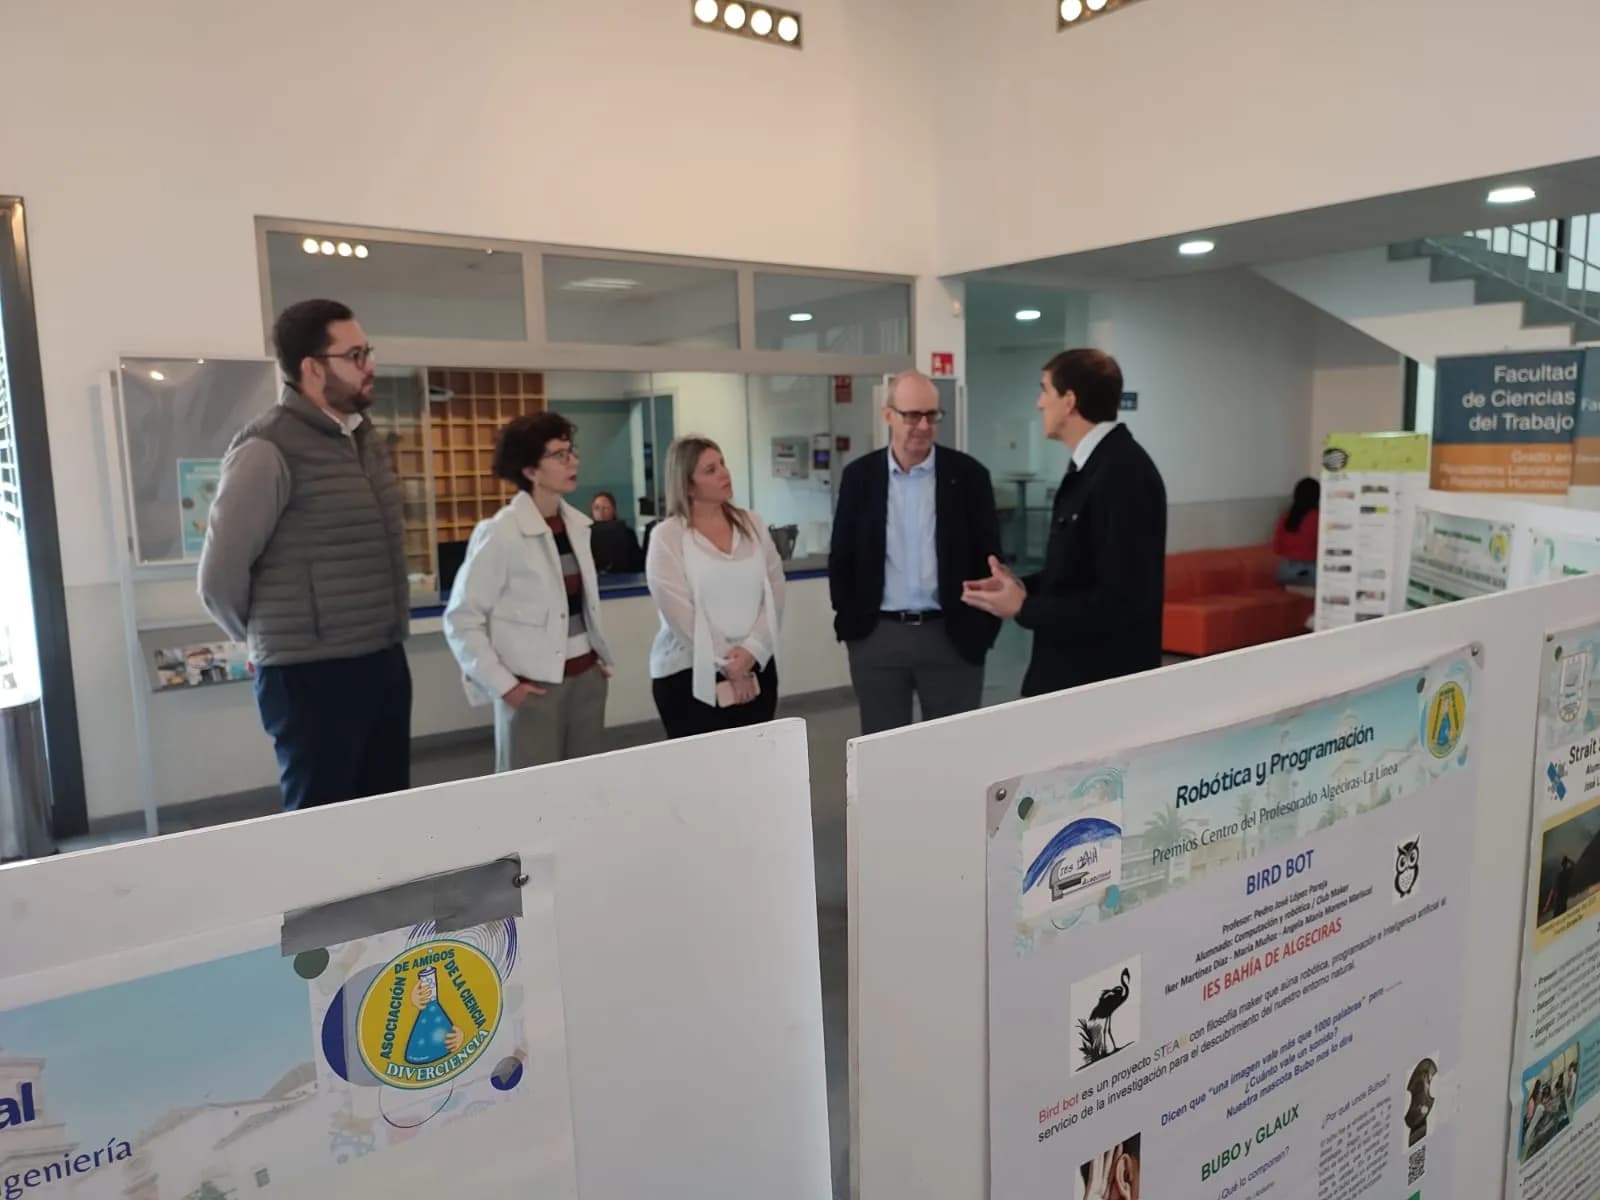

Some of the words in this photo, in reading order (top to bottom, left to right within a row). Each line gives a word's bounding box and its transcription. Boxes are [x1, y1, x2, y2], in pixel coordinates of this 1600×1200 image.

[1462, 391, 1486, 409] de
[1491, 388, 1576, 407] Ciencias
[1494, 363, 1578, 383] Facultad
[1469, 414, 1498, 431] del
[1502, 412, 1574, 433] Trabajo
[1175, 767, 1251, 808] Robótica
[1255, 761, 1266, 786] y
[1270, 726, 1374, 774] Programación
[1569, 738, 1597, 765] Strait
[1152, 837, 1198, 865] Premios
[1200, 823, 1238, 846] Centro
[1240, 811, 1256, 831] del
[1259, 791, 1318, 823] Profesorado
[1246, 864, 1282, 895] BIRD
[1285, 849, 1314, 878] BOT
[1222, 914, 1252, 934] Profesor:
[1234, 917, 1278, 943] Computación
[1279, 915, 1283, 924] y
[394, 961, 409, 975] DE
[412, 949, 456, 969] AMIGOS
[1202, 978, 1221, 1001] IES
[1224, 957, 1262, 989] BAHÍA
[1264, 947, 1280, 968] DE
[1282, 917, 1342, 959] ALGECIRAS
[444, 959, 460, 978] DE
[452, 976, 466, 991] LA
[460, 988, 487, 1029] CIENCIA
[1164, 981, 1179, 995] Iker
[380, 976, 407, 1060] ASOCIACIÓN
[386, 1029, 491, 1082] DIVERCIENCIA
[1038, 1101, 1060, 1124] Bird
[1062, 1092, 1079, 1111] bot
[1081, 1087, 1094, 1100] es
[1096, 1079, 1109, 1093] un
[1111, 1056, 1151, 1088] proyecto
[1189, 1027, 1205, 1042] con
[1238, 994, 1263, 1014] maker
[1264, 986, 1279, 1001] que
[1038, 1113, 1078, 1142] servicio
[1080, 1105, 1094, 1119] de
[1096, 1099, 1105, 1111] la
[1107, 1065, 1167, 1104] investigación
[1168, 1053, 1189, 1073] para
[1190, 1044, 1199, 1059] el
[1200, 1013, 1259, 1053] descubrimiento
[1260, 1002, 1273, 1018] del
[1279, 1053, 1296, 1069] vale
[0, 1082, 36, 1130] al
[1161, 1104, 1187, 1126] Dicen
[1189, 1093, 1206, 1110] que
[1230, 1060, 1261, 1084] imagen
[1261, 1049, 1279, 1064] vale
[1226, 1093, 1258, 1119] Nuestra
[1259, 1071, 1292, 1098] mascota
[1293, 1058, 1315, 1076] Bubo
[0, 1137, 133, 1200] geniería
[1201, 1142, 1241, 1181] BUBO
[1244, 1138, 1252, 1157] y
[1255, 1103, 1299, 1144] GLAUX
